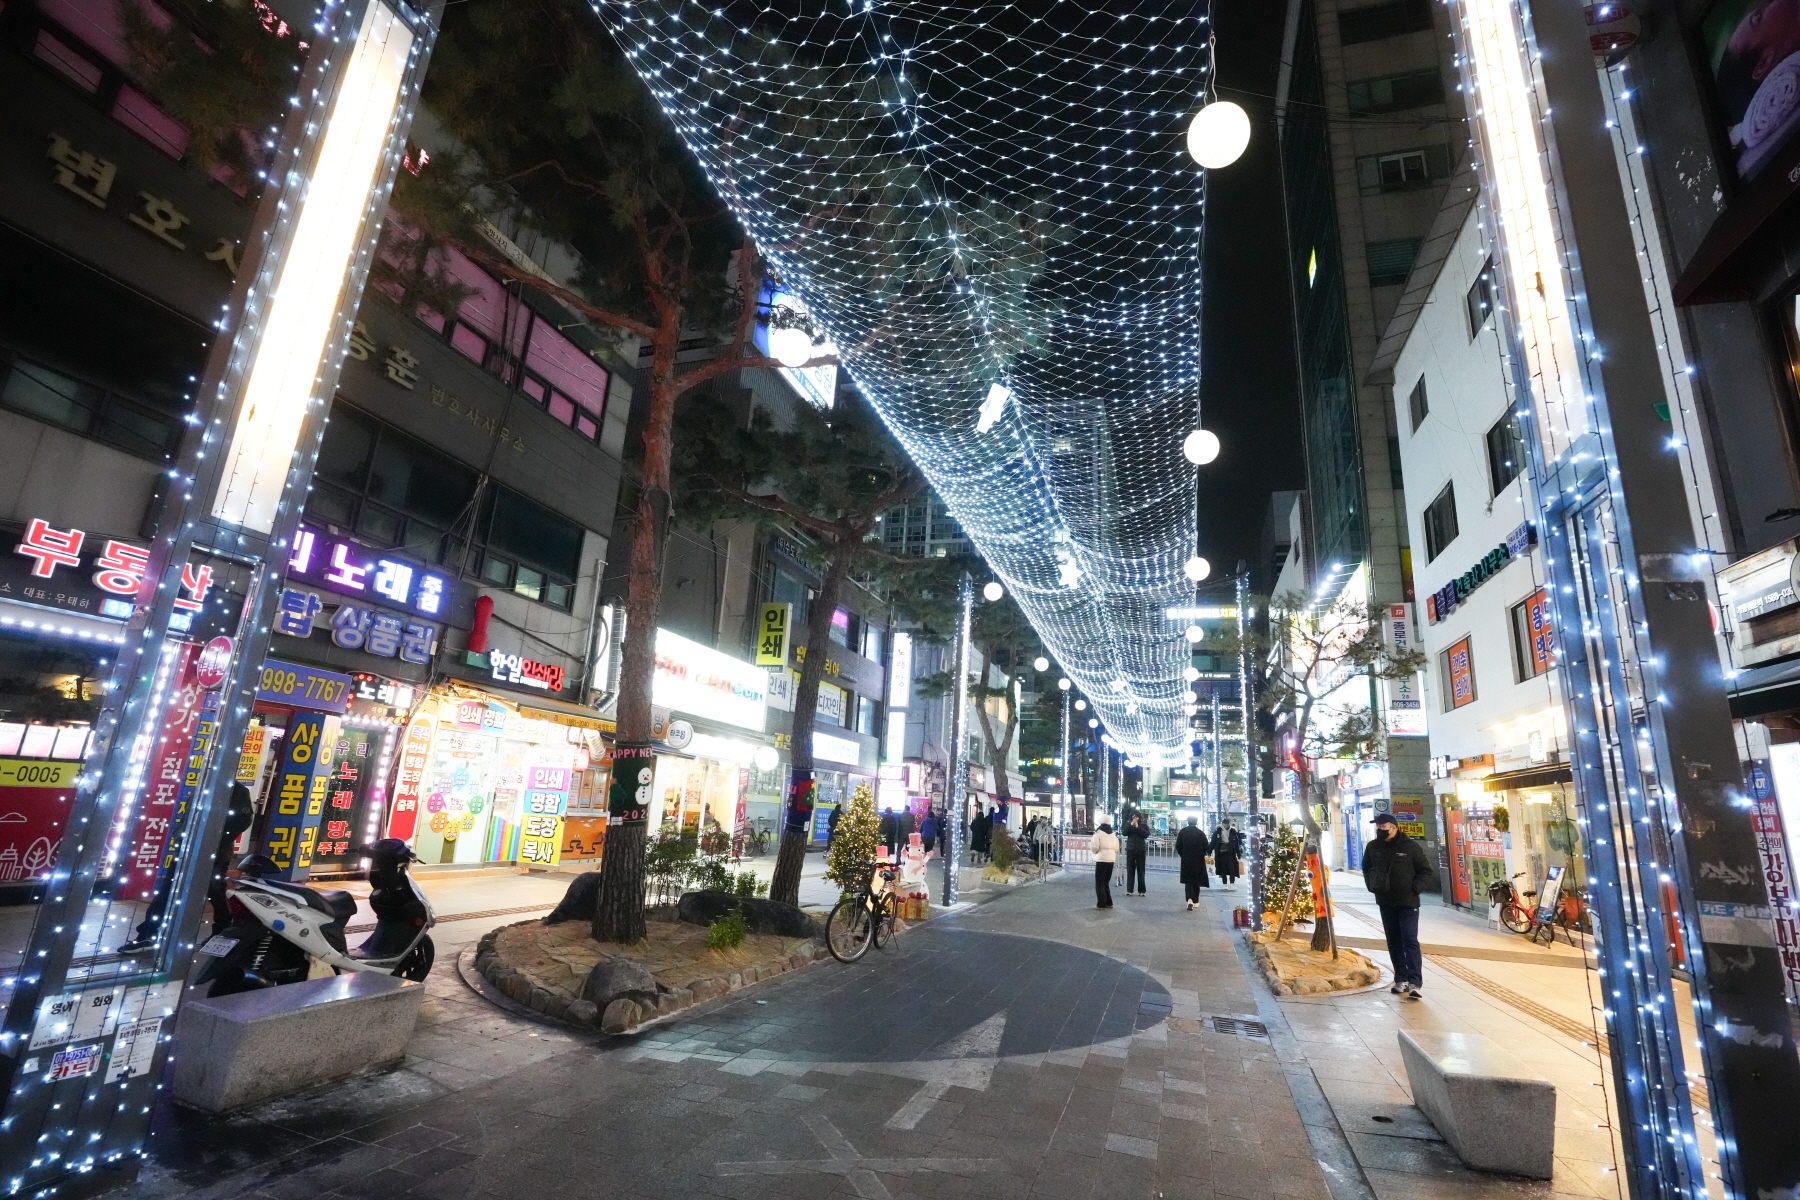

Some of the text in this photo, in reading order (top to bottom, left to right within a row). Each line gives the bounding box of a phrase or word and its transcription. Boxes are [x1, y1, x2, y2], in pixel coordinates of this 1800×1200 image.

[431, 384, 526, 453] 변호사사무소
[14, 518, 213, 611] 부동산
[330, 604, 436, 664] 상품권
[761, 609, 785, 659] 인쇄
[261, 668, 345, 703] 998-7767
[356, 681, 412, 708] 노래
[769, 676, 787, 699] 인쇄
[460, 705, 483, 725] 인쇄
[484, 709, 507, 729] 명함
[818, 694, 839, 717] 디자인
[244, 728, 265, 742] 임대
[241, 742, 262, 755] 문의
[335, 740, 370, 758] 우리
[407, 742, 428, 755] 인쇄
[613, 749, 637, 760] APPY
[405, 755, 425, 769] 명함
[1429, 756, 1447, 780] 한일
[0, 765, 61, 783] -0005
[402, 769, 422, 783] 도장
[533, 768, 565, 791] 인쇄
[267, 721, 319, 869] 상품권
[297, 721, 337, 868] 상품권
[326, 762, 358, 839] 노래방
[399, 785, 420, 797] 복사
[530, 791, 561, 814] 명함
[396, 799, 416, 812] 출력
[622, 809, 647, 820] 202
[525, 815, 558, 839] 도장
[522, 839, 554, 863] 복사
[1762, 853, 1800, 983] 강북다방
[51, 995, 113, 1015] 영어 회화
